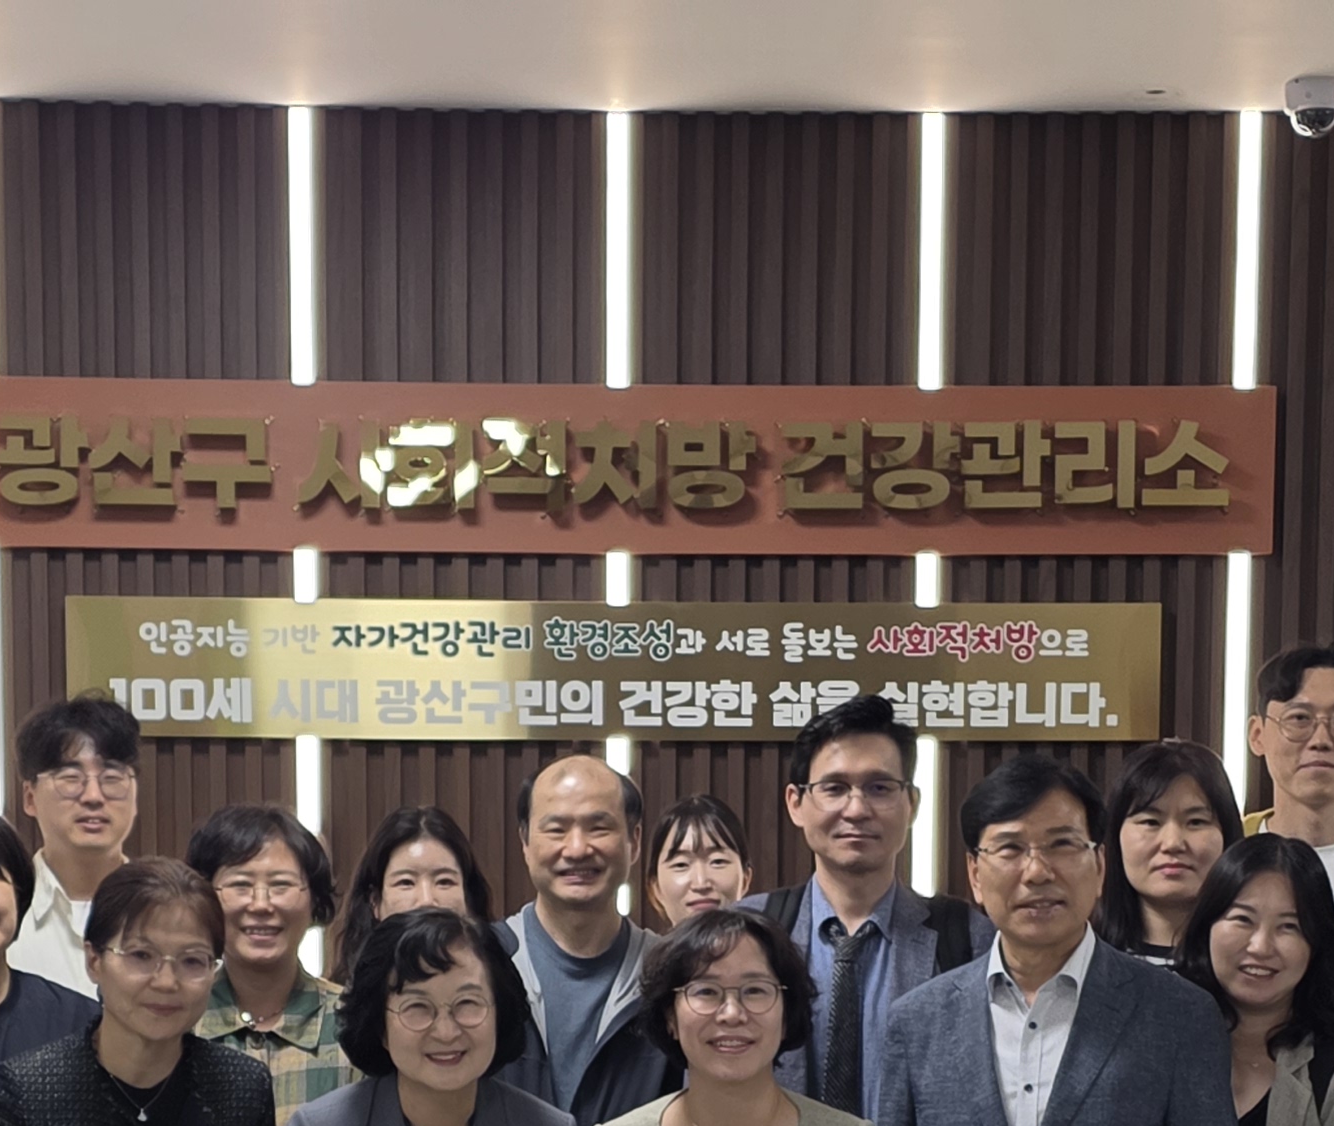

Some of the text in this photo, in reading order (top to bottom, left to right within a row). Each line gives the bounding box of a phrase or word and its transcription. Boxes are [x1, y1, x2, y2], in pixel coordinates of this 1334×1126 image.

[297, 417, 758, 513] 사회적처방
[779, 418, 1231, 512] 건강관리소
[139, 618, 1090, 662] 인공지능 기반 자가건강관리 환경조성과 서로 돌보는 사회적처방으로
[108, 677, 253, 723] 100세
[271, 678, 359, 725] 시대
[375, 679, 604, 726] 광산구민의
[618, 680, 759, 728] 건강한
[878, 680, 1119, 728] 실현합니다.
